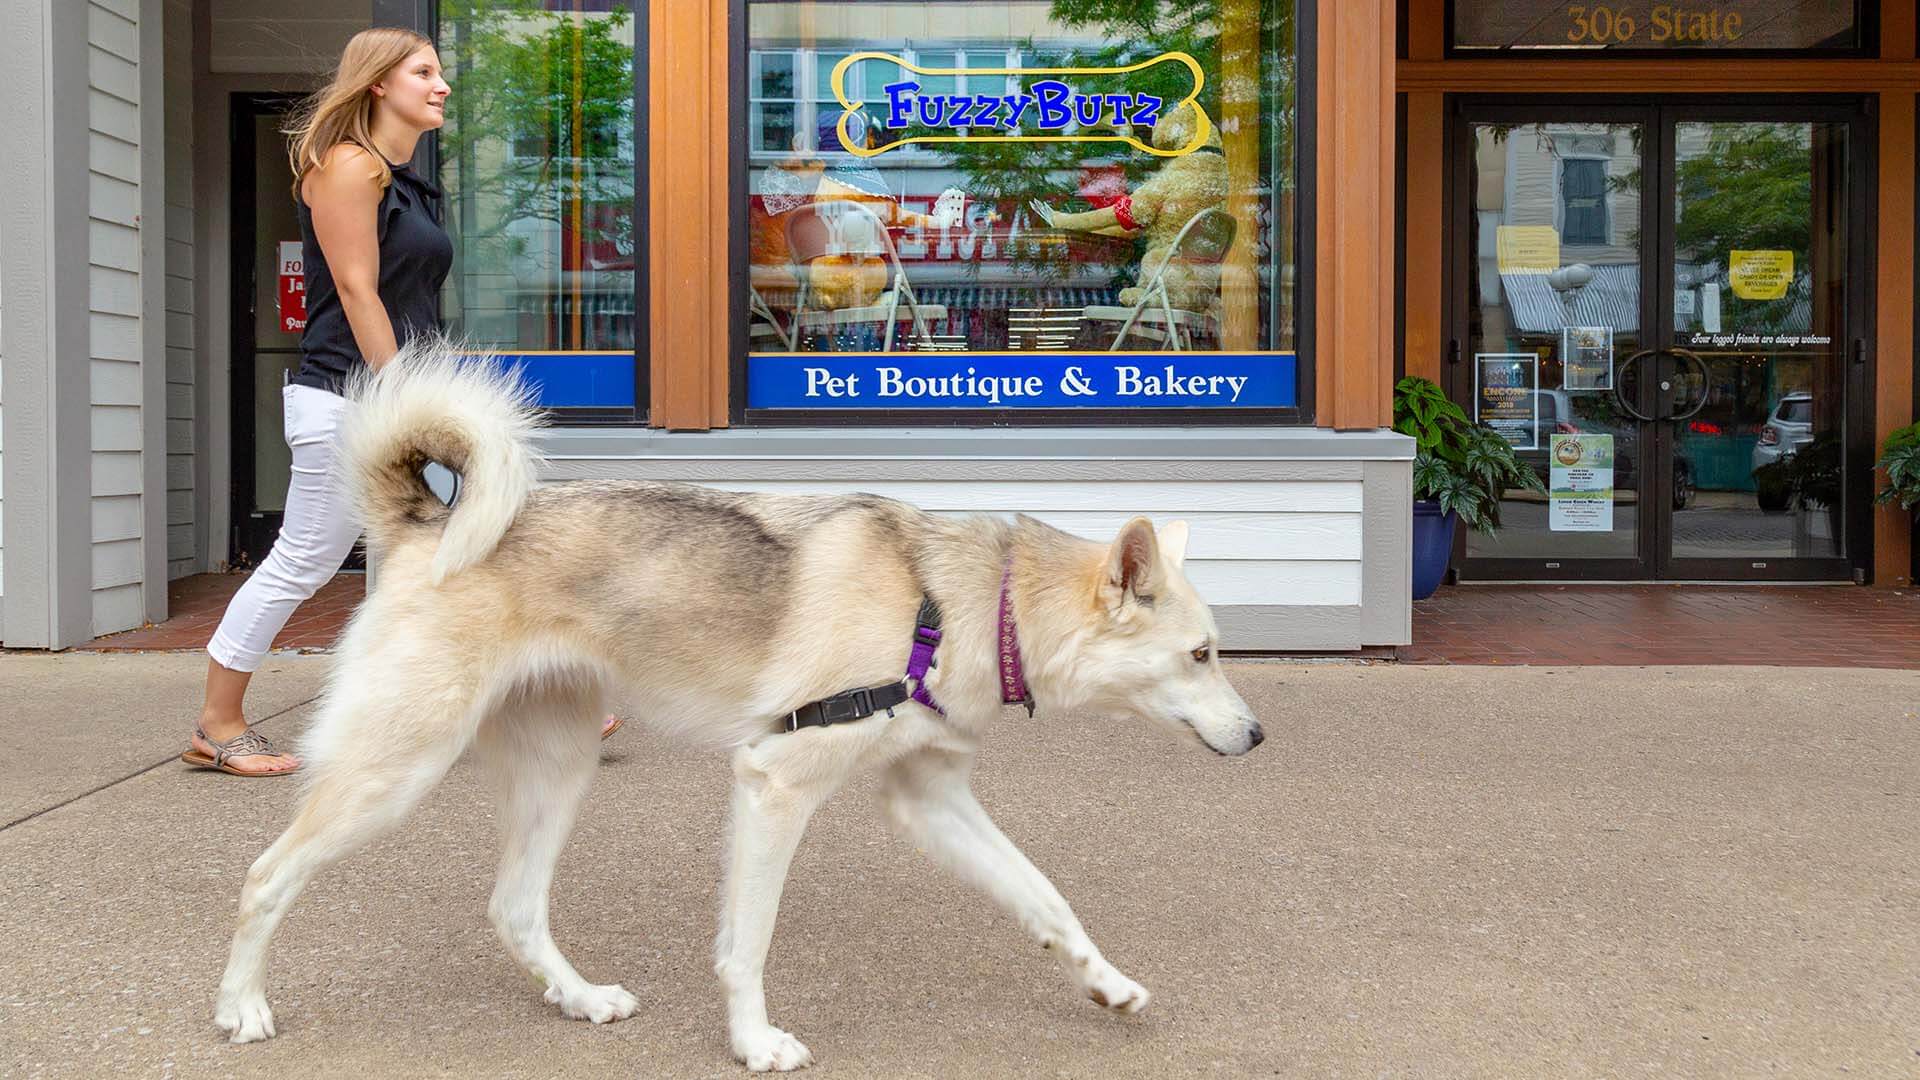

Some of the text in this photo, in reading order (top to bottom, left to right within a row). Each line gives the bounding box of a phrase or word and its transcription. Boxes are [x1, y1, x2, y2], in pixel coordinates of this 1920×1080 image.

[1567, 4, 1743, 42] 306 State
[285, 260, 304, 273] FO
[288, 277, 304, 294] Ja
[286, 316, 307, 330] Par
[1734, 332, 1760, 347] friends
[1761, 335, 1774, 344] are
[1775, 333, 1800, 347] always
[1801, 334, 1831, 344] welcome
[803, 364, 1249, 402] Pet Boutique & Bakery
